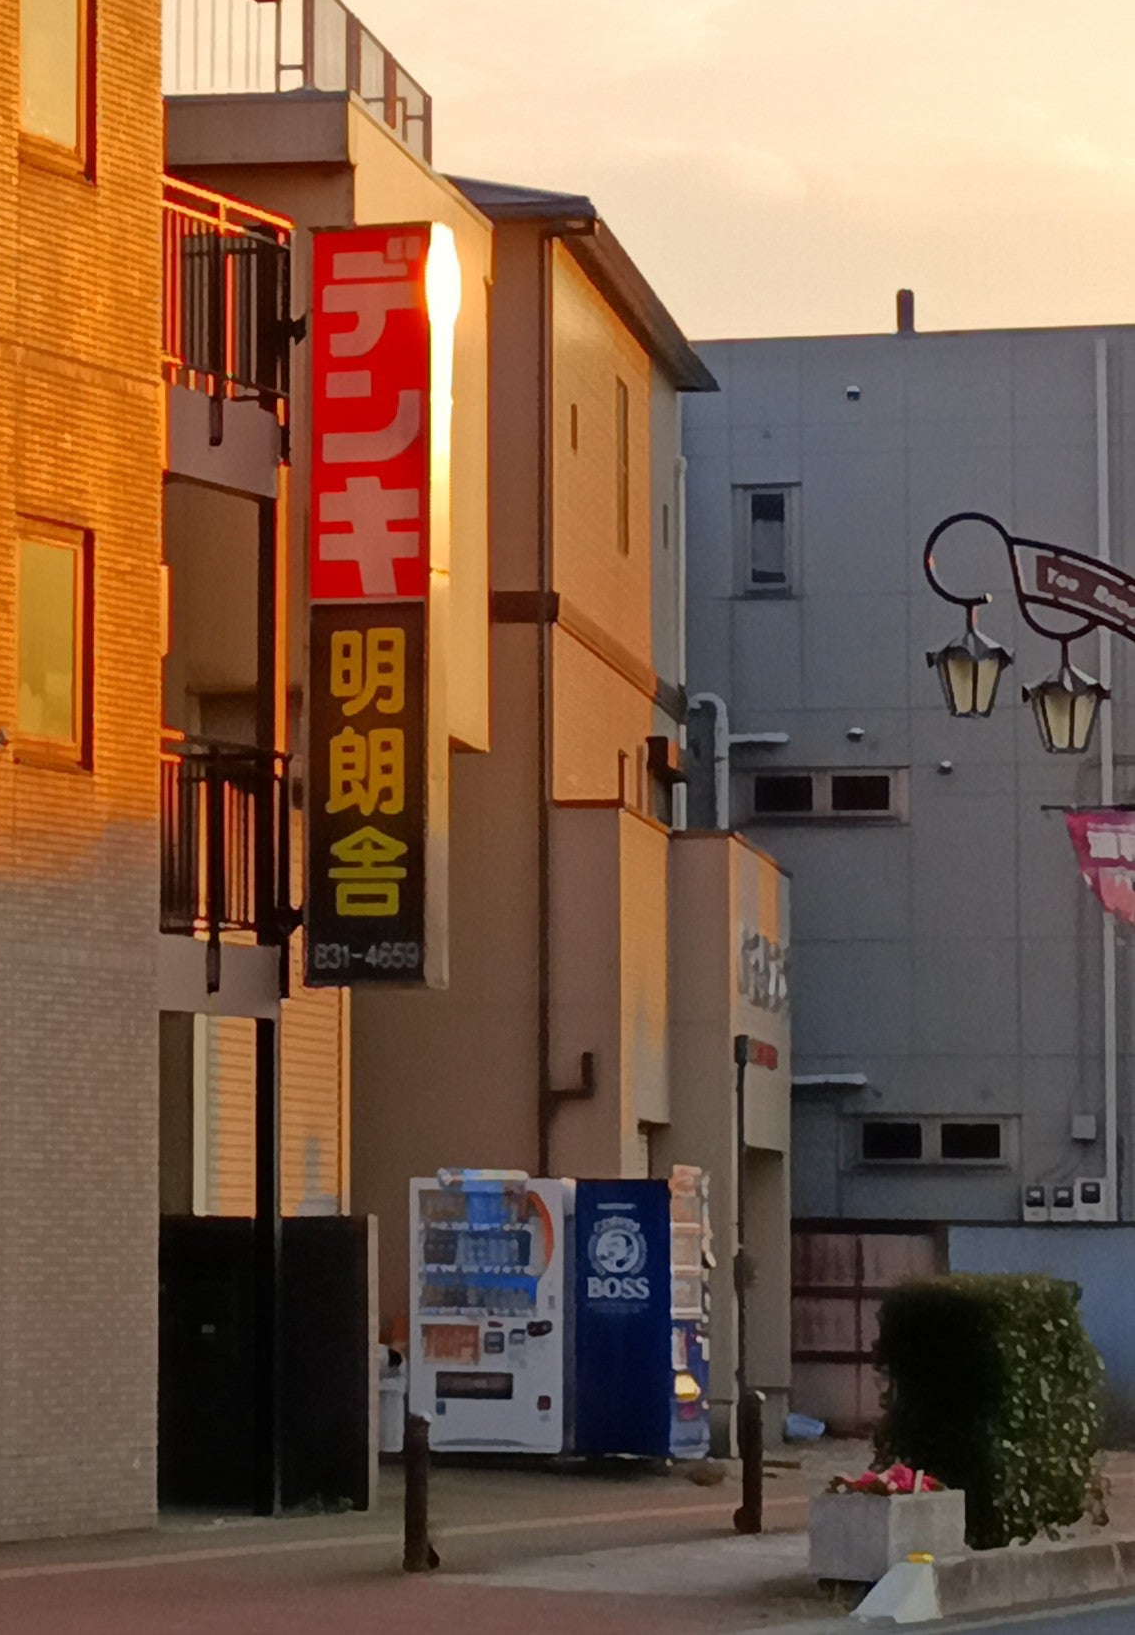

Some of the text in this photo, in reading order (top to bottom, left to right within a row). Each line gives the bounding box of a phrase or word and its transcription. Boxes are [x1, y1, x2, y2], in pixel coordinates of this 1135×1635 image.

[319, 236, 421, 596] デンキ
[587, 1276, 651, 1300] BOSS
